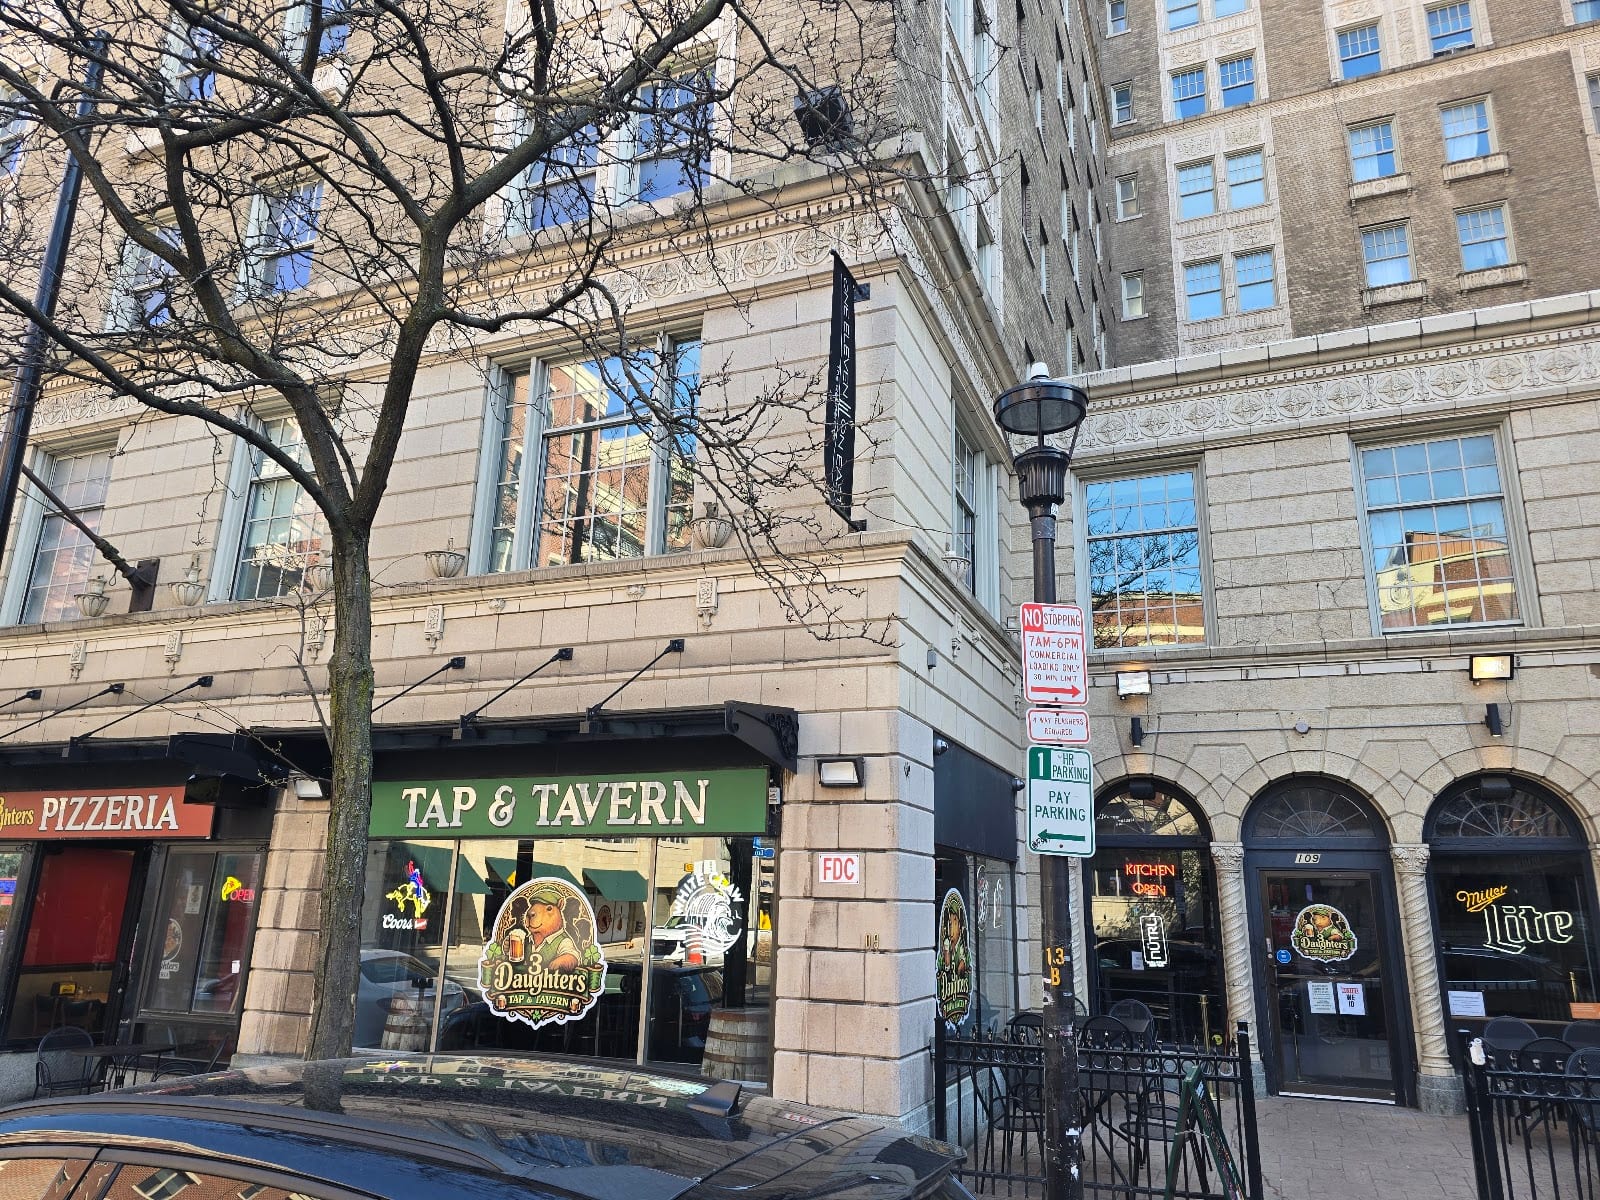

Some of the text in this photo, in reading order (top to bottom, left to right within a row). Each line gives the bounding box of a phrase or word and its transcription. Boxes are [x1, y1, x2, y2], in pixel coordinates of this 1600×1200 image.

[842, 321, 850, 399] ELEVEN
[1024, 608, 1081, 627] NO STOPPING
[1028, 635, 1079, 649] 7AM-6PM
[1029, 650, 1079, 661] COMMERCIAL
[1029, 662, 1080, 673] LOADING ONLY
[1033, 673, 1042, 681] 30
[1054, 717, 1084, 726] FLASHERS
[1044, 727, 1073, 736] REQUIRED
[1037, 752, 1044, 777] 1
[1062, 753, 1075, 765] HR
[1052, 764, 1089, 780] PARKING
[402, 779, 710, 829] TAP & TAVERN
[1048, 790, 1072, 805] PAY
[38, 795, 179, 831] PIZZERIA
[1034, 805, 1087, 822] PARKING
[1297, 854, 1319, 863] 109
[823, 857, 855, 881] FDC
[1125, 864, 1175, 876] KITCHEN
[230, 889, 255, 901] OPEN
[672, 871, 706, 915] WHITE
[1132, 882, 1166, 897] OPEN
[1456, 885, 1508, 907] Miller
[382, 913, 413, 930] Coors
[1483, 904, 1574, 954] Lite
[1300, 936, 1348, 950] Daughters
[528, 953, 543, 975] 3
[494, 961, 586, 996] Daughters
[508, 994, 524, 1004] TAP
[535, 994, 570, 1008] TAVERN
